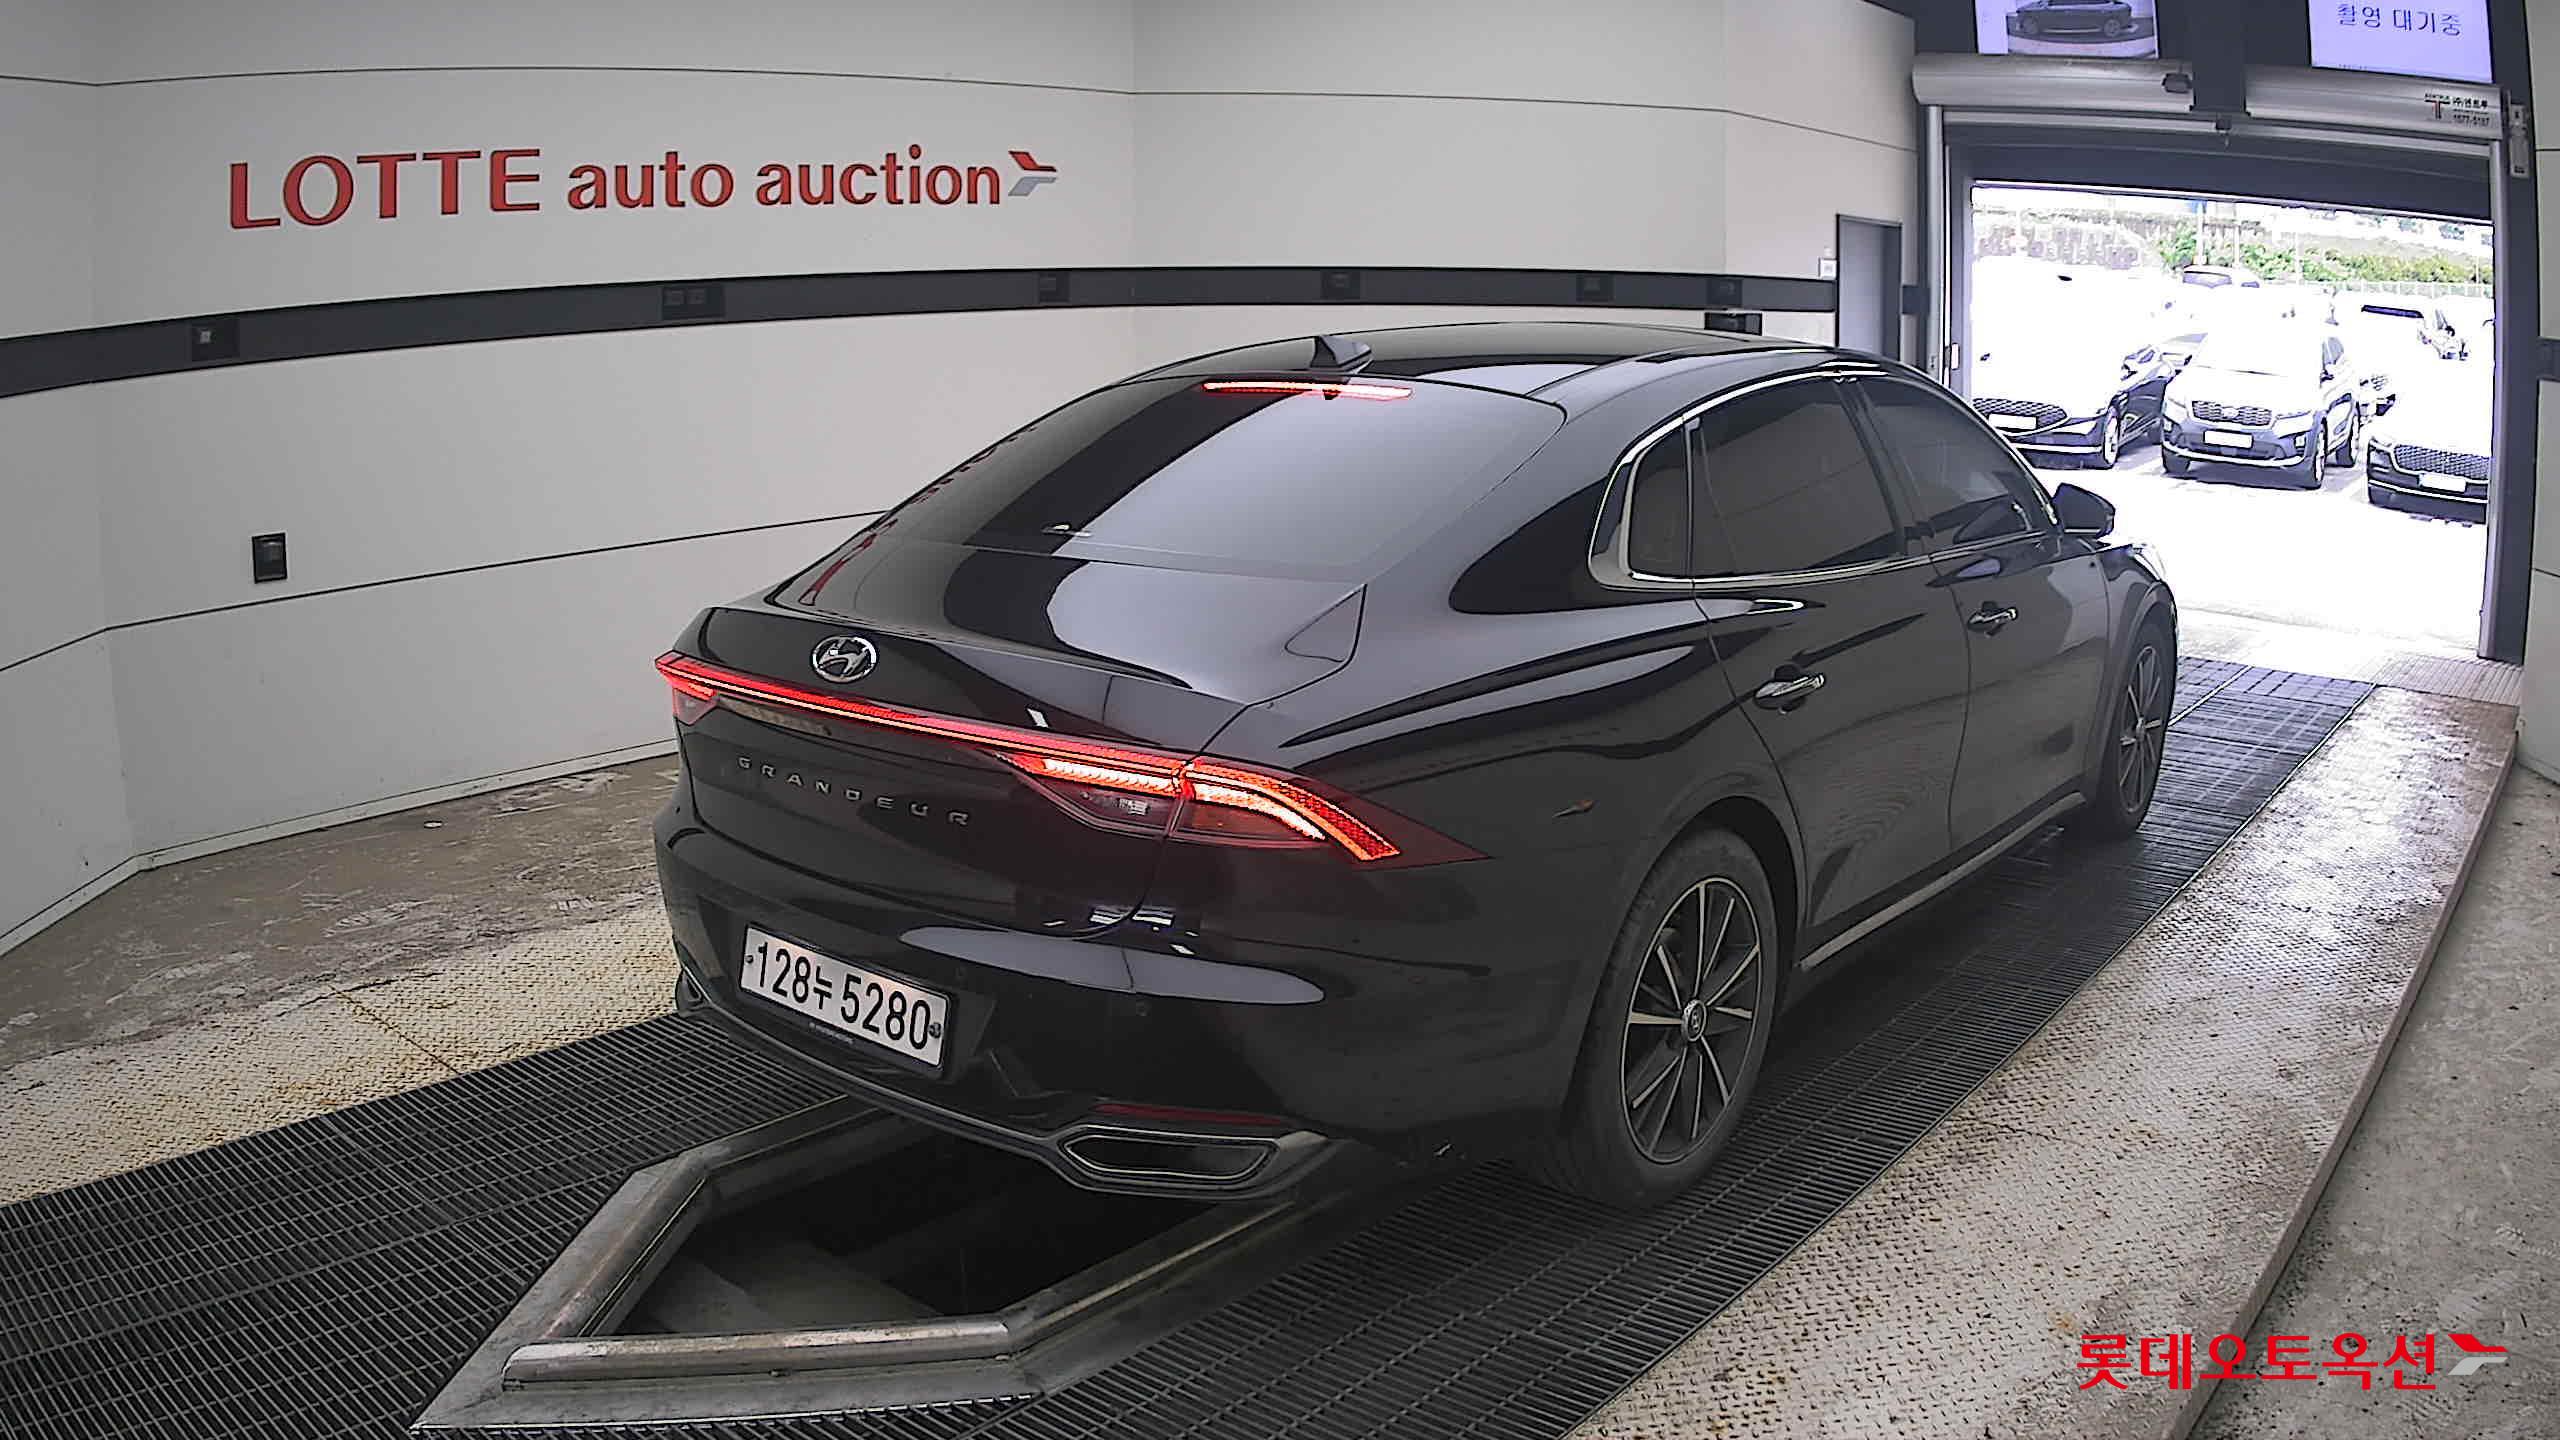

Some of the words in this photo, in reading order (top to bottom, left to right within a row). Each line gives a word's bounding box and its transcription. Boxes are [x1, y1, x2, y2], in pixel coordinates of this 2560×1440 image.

[2338, 3, 2381, 28] 촬영
[2393, 9, 2461, 36] 대기중
[229, 148, 542, 230] LOTTE
[567, 150, 734, 209] auto
[755, 144, 1001, 208] auction
[738, 755, 969, 826] GRANDEUR
[757, 941, 833, 1010] 128누
[840, 973, 931, 1050] 5280
